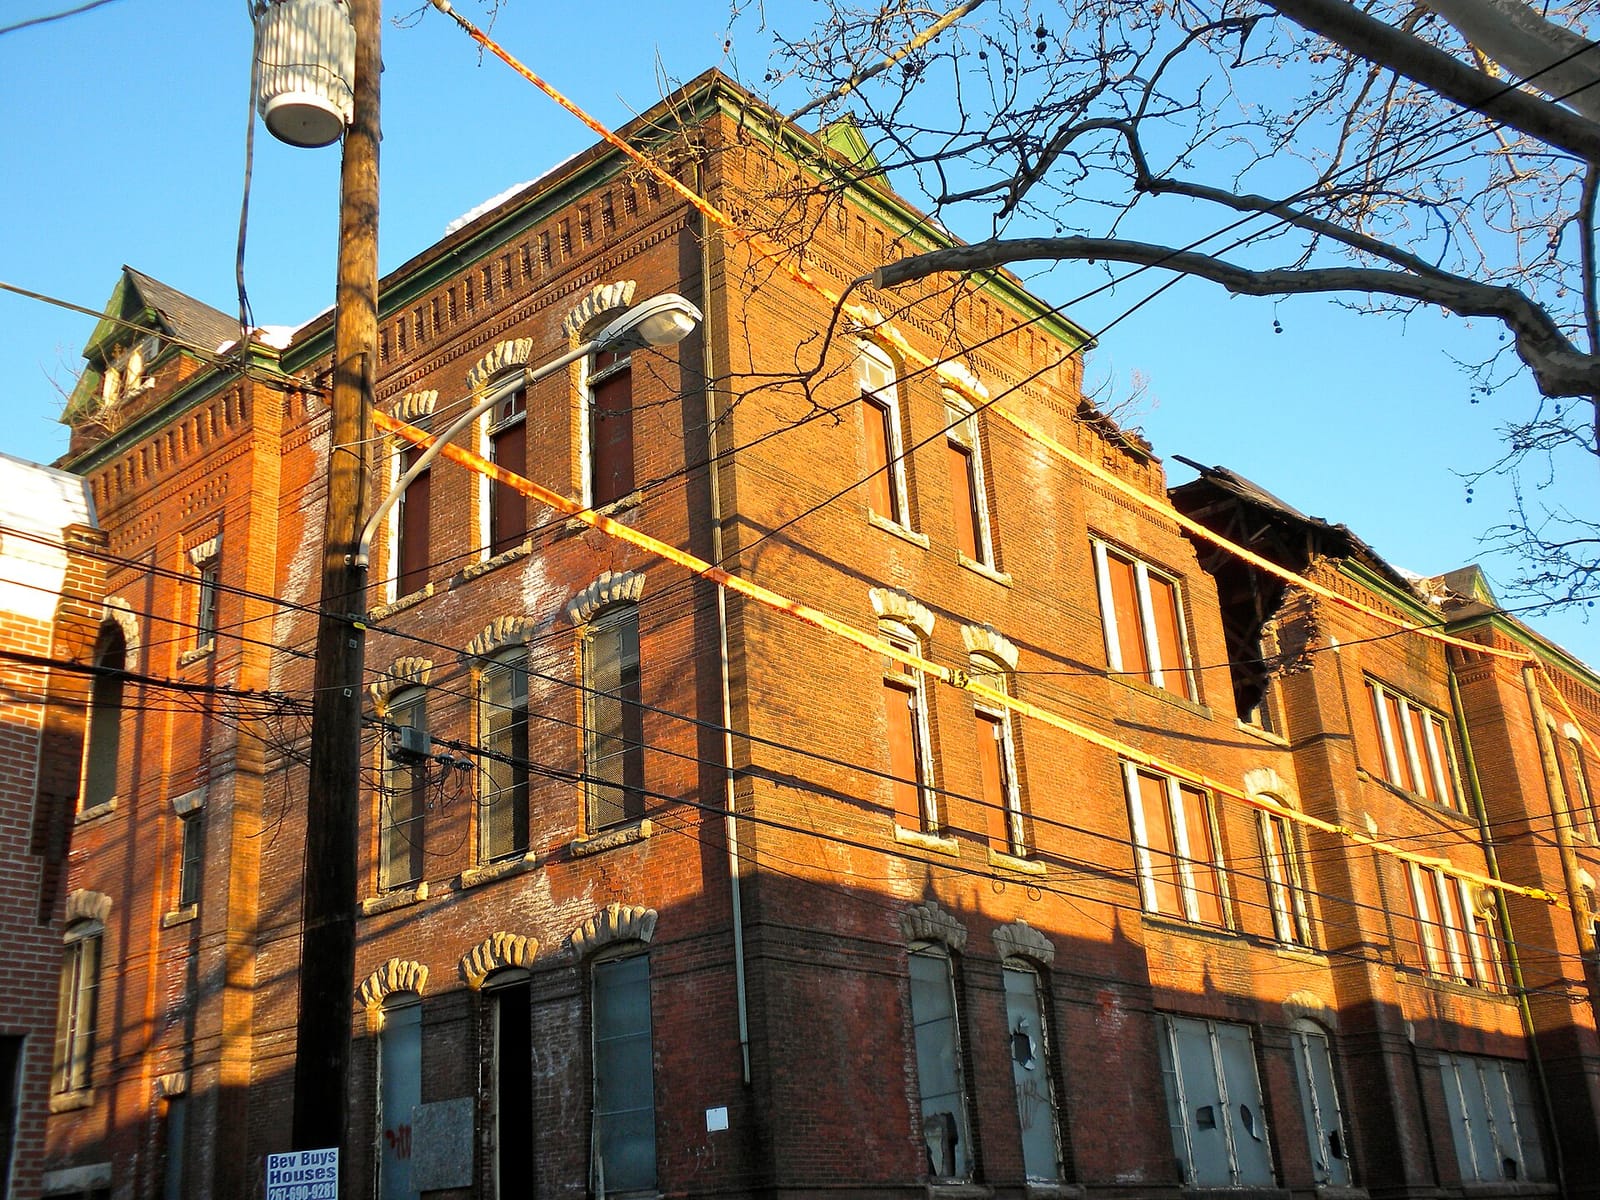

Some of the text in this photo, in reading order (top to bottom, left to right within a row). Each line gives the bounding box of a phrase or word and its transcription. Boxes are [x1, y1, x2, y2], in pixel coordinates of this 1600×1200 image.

[270, 1152, 336, 1169] Bev Buys
[270, 1167, 336, 1184] Houses
